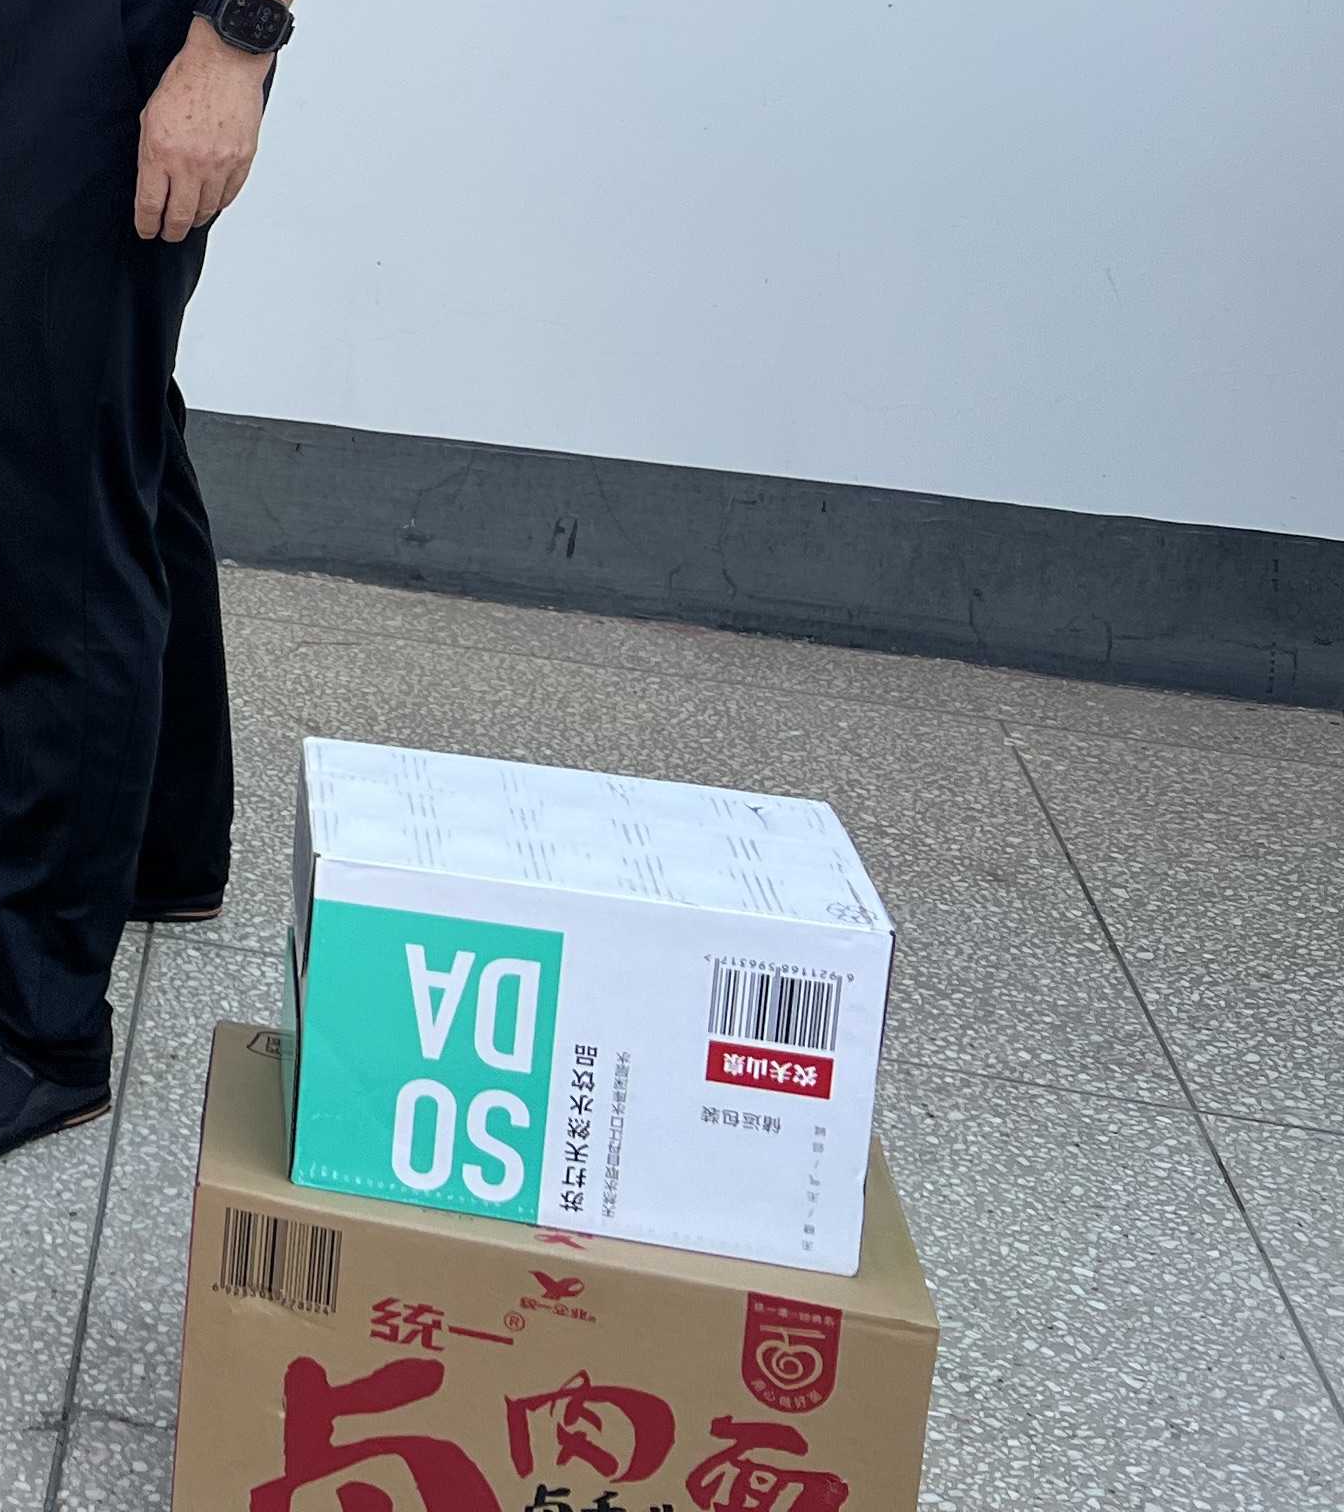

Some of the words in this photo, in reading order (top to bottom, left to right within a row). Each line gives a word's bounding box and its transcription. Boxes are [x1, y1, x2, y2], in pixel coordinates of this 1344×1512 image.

[405, 943, 542, 1075] DA
[722, 1053, 819, 1088] 农夫山泉
[391, 1079, 531, 1202] SO
[558, 1044, 598, 1213] 苏打天然水饮品
[700, 1106, 781, 1134] 储运包装
[369, 1297, 514, 1352] 统一
